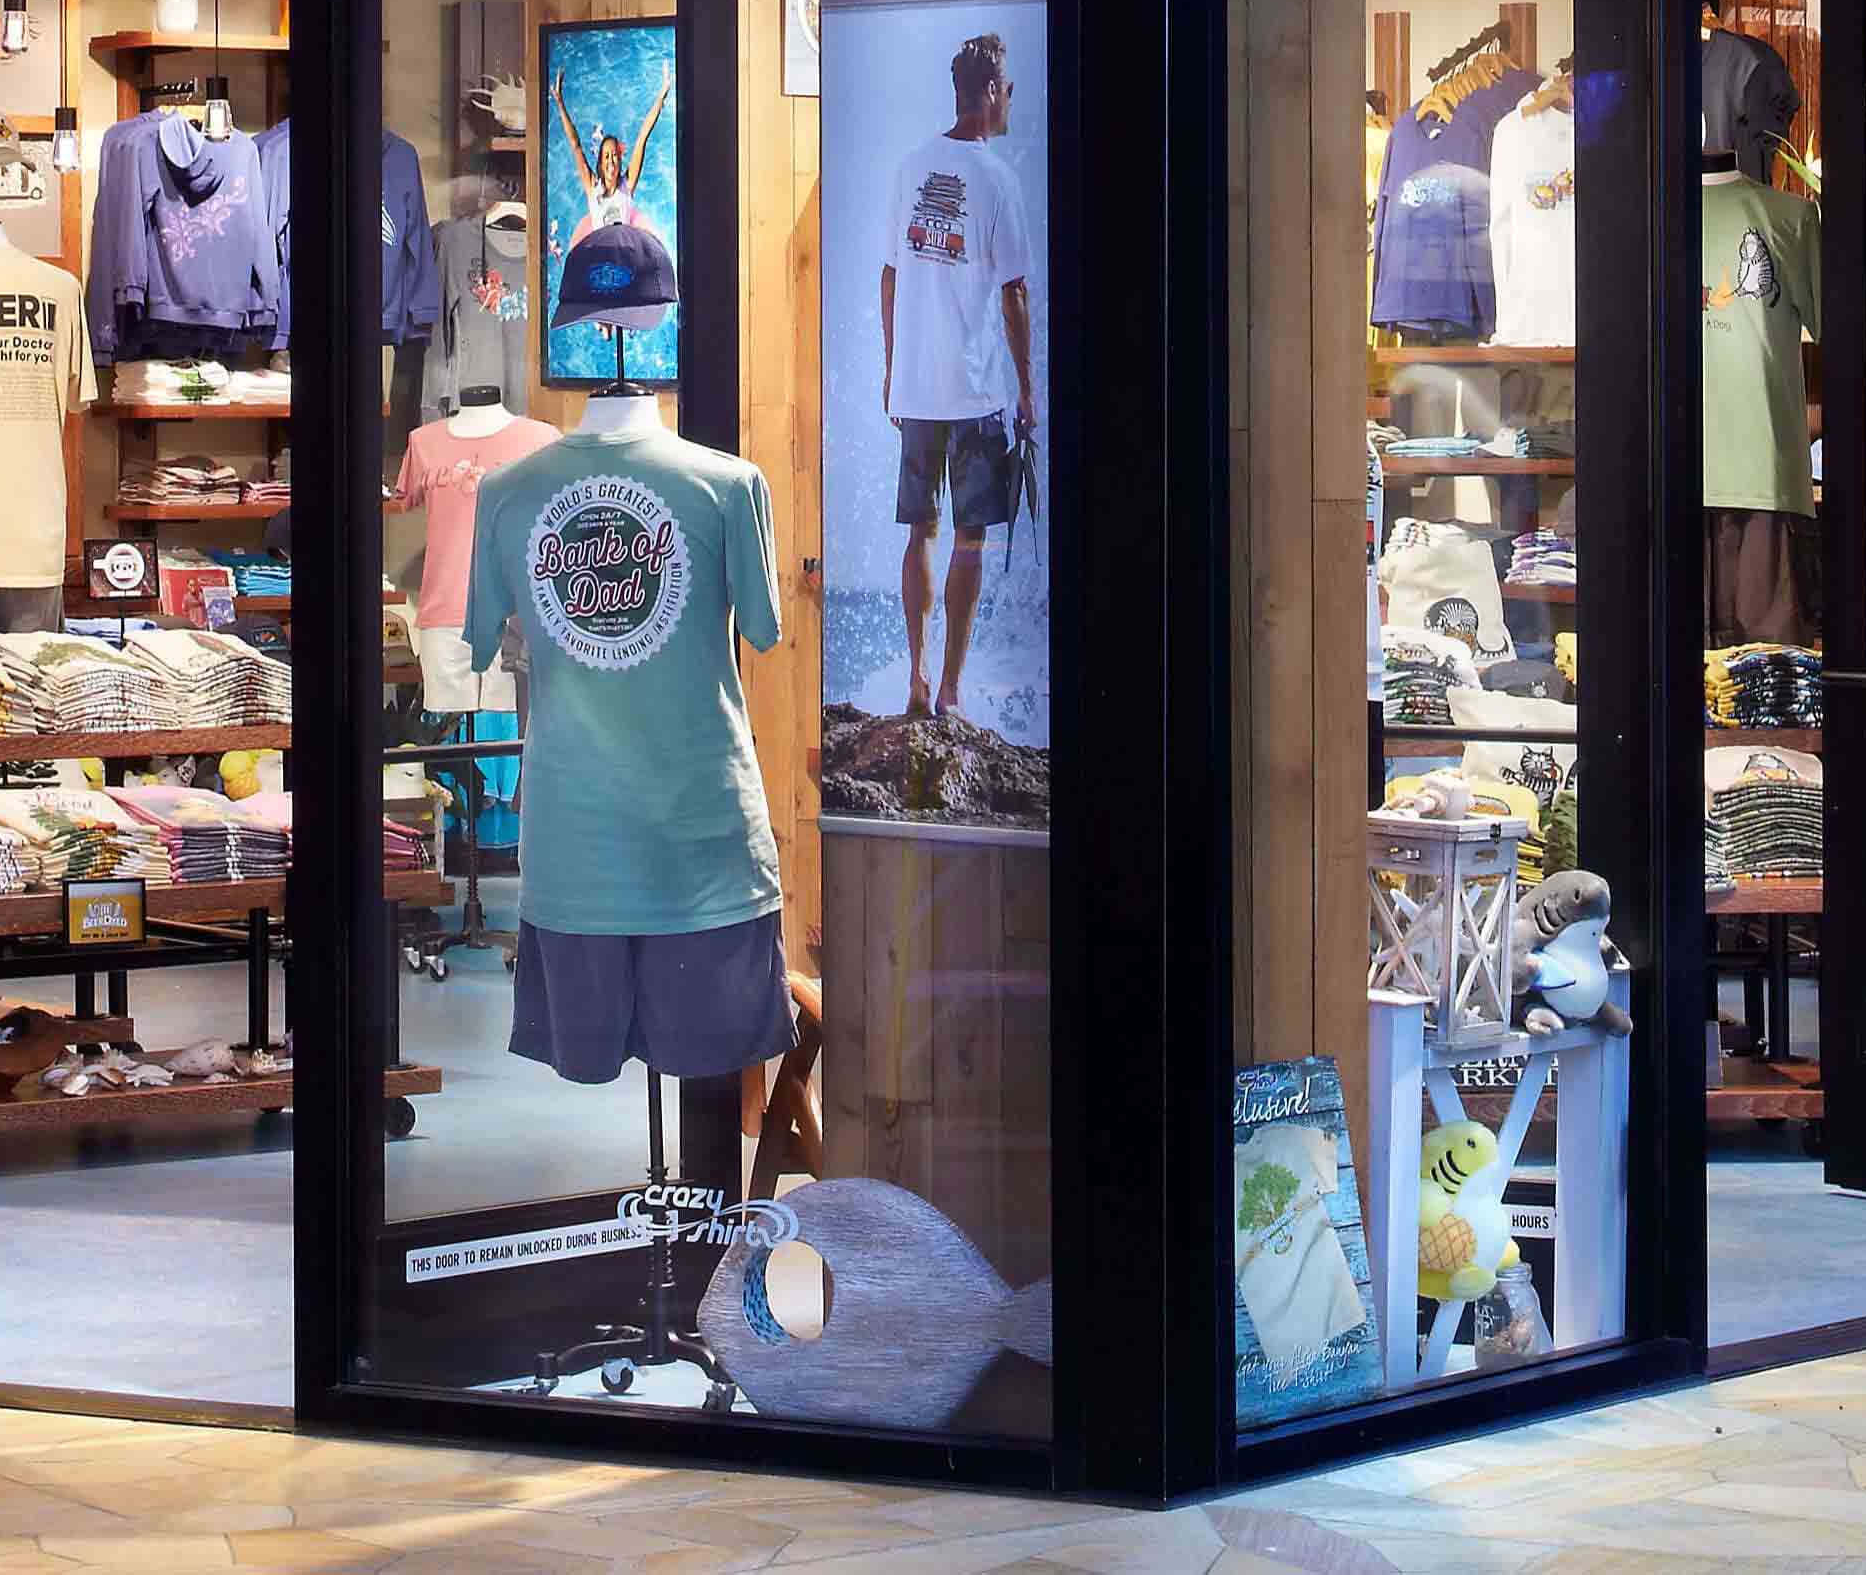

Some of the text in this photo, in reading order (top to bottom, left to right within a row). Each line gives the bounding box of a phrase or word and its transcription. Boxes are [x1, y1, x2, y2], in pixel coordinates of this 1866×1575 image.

[15, 349, 31, 362] for
[543, 483, 662, 530] WORLD'S GREATEST
[535, 520, 675, 581] Bank of
[565, 568, 645, 617] Dad
[643, 1183, 726, 1217] crazy
[1511, 1213, 1550, 1230] HOURS
[411, 1257, 432, 1272] THIS
[435, 1253, 461, 1269] DOOR
[464, 1251, 477, 1267] TO
[479, 1245, 514, 1265] REMAIN
[517, 1238, 564, 1259] UNLOCKED
[566, 1232, 599, 1250] DURING
